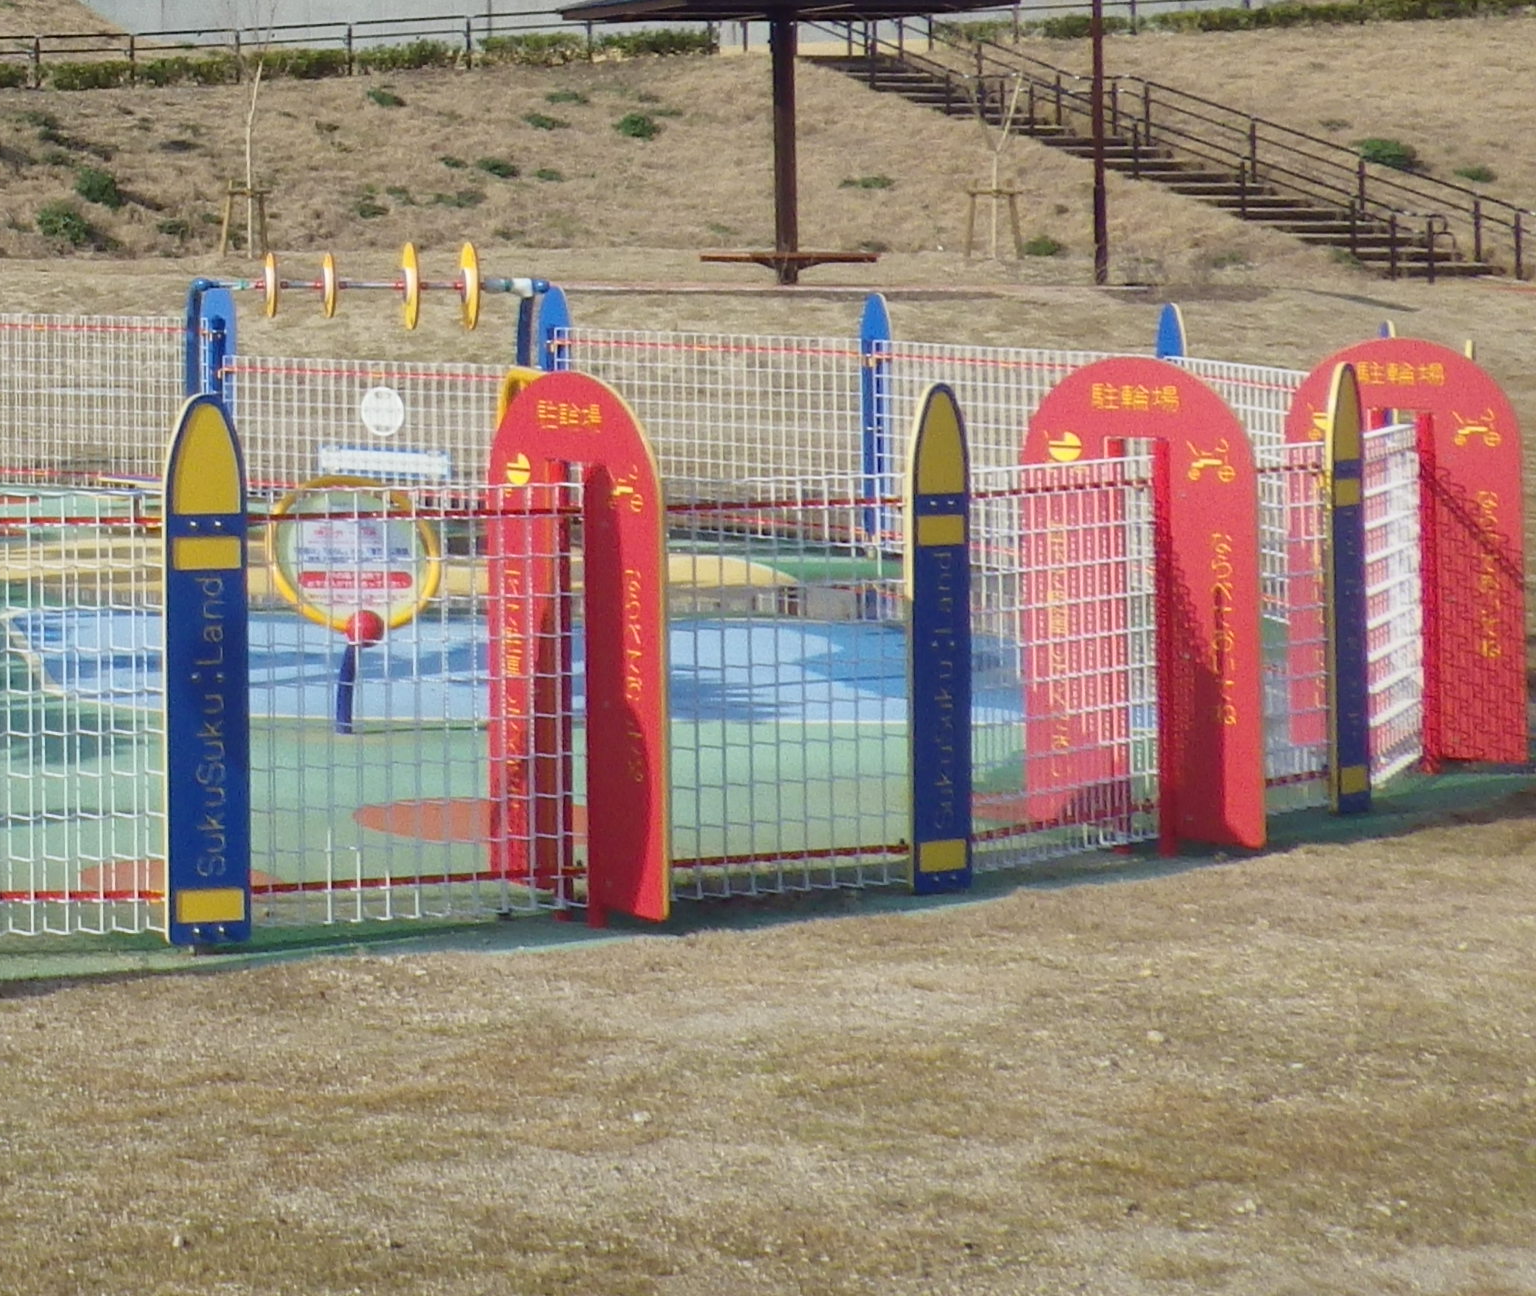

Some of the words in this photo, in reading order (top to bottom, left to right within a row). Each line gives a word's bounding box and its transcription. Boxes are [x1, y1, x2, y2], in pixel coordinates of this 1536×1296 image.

[1091, 383, 1181, 412] 駐輪場
[197, 575, 225, 667] Land
[196, 693, 227, 879] SukuSuku
